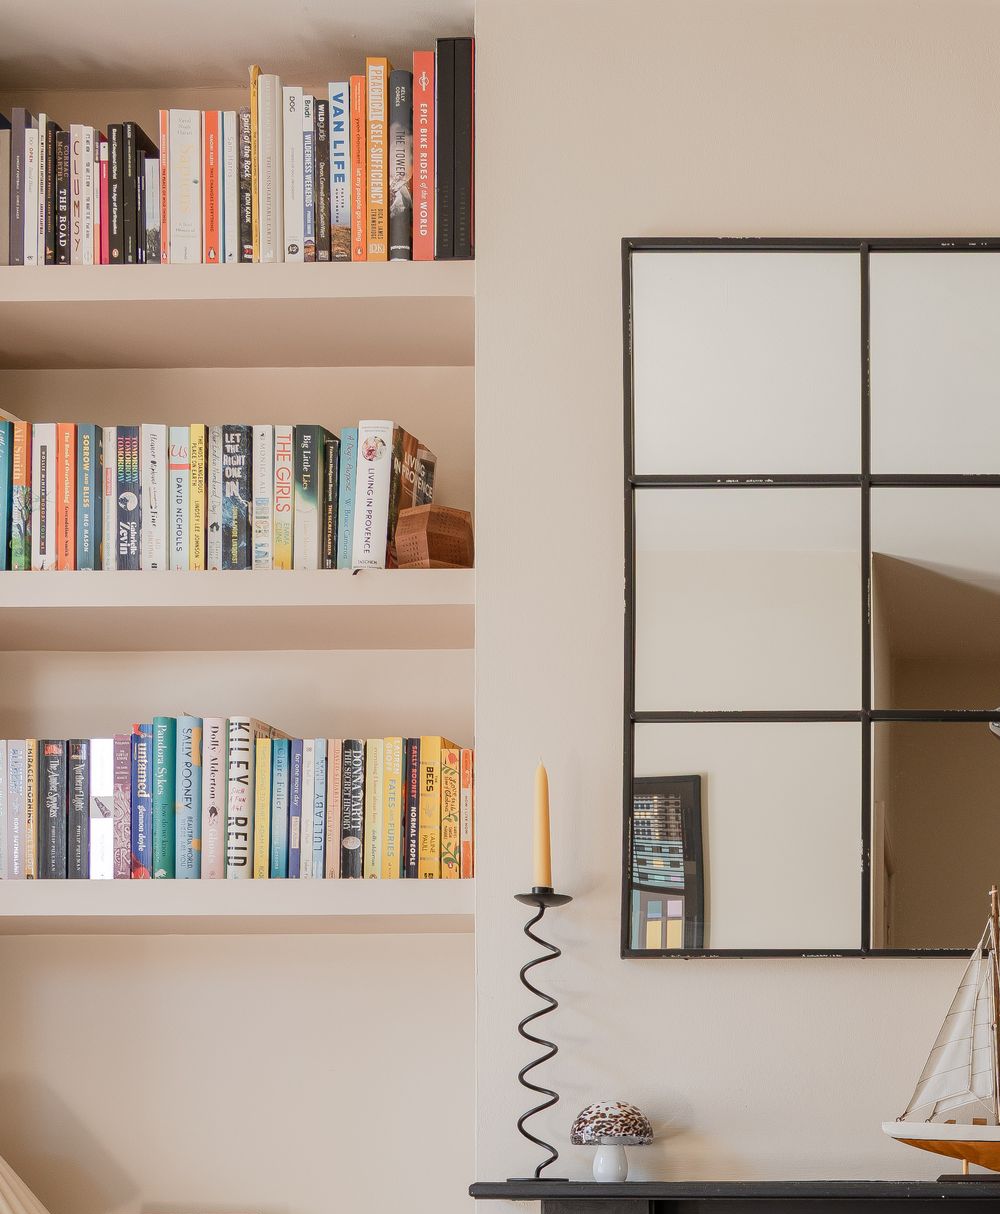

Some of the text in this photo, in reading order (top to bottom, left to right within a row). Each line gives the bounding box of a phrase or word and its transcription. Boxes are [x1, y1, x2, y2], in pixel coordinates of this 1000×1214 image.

[242, 113, 252, 134] Spirit
[369, 66, 384, 205] PRACTICAL SELF-SUFFICIENCY
[419, 103, 428, 125] EPIC
[244, 135, 252, 145] of
[244, 145, 252, 158] the
[332, 92, 345, 183] VAN LIFE
[395, 130, 405, 178] THE TOWER
[419, 128, 428, 149] BIKE
[244, 159, 252, 178] Rock
[304, 134, 312, 208] WILDERNESS WEEKENDS
[419, 152, 428, 180] RIDES
[73, 140, 81, 252] CLUMSY
[59, 189, 67, 247] THE ROAD
[419, 201, 428, 236] WORLD
[13, 425, 24, 480] Ali Smith
[82, 434, 90, 471] SORROW
[117, 436, 125, 483] TOMORROW
[149, 433, 158, 458] Eleanor
[171, 445, 188, 458] Us
[223, 454, 246, 466] RIGHT
[225, 433, 241, 444] LET
[225, 444, 240, 453] THE
[191, 459, 198, 468] ON
[225, 466, 242, 478] ONE
[275, 433, 291, 512] THE GIRLS
[301, 434, 311, 491] Big Little Lies
[82, 486, 90, 508] BLISS
[226, 481, 239, 497] IN
[363, 467, 375, 554] LIVING IN PROVENCE
[119, 521, 130, 555] Zevin
[130, 521, 138, 555] Gabrielle
[150, 511, 158, 527] Fine
[157, 724, 167, 764] Pandora
[209, 725, 219, 799] Dolly Alderton
[229, 722, 249, 786] KILEY
[393, 740, 401, 774] LAUREN
[72, 764, 86, 812] Northern Lights
[137, 742, 150, 798] untamed
[157, 767, 167, 795] Sykes
[181, 727, 193, 810] SALLY ROONEY
[275, 747, 284, 810] Claire Fuller
[343, 749, 352, 831] THE SECRET HISTORY
[351, 749, 362, 831] DONNA TARTT
[426, 766, 434, 792] BEES
[137, 804, 146, 852] glennon doyle
[161, 803, 169, 857] how do we know
[314, 793, 324, 851] LULLABY
[387, 779, 396, 857] FATES FURIES
[409, 806, 417, 866] NORMAL PEOPLE
[227, 816, 248, 867] REID
